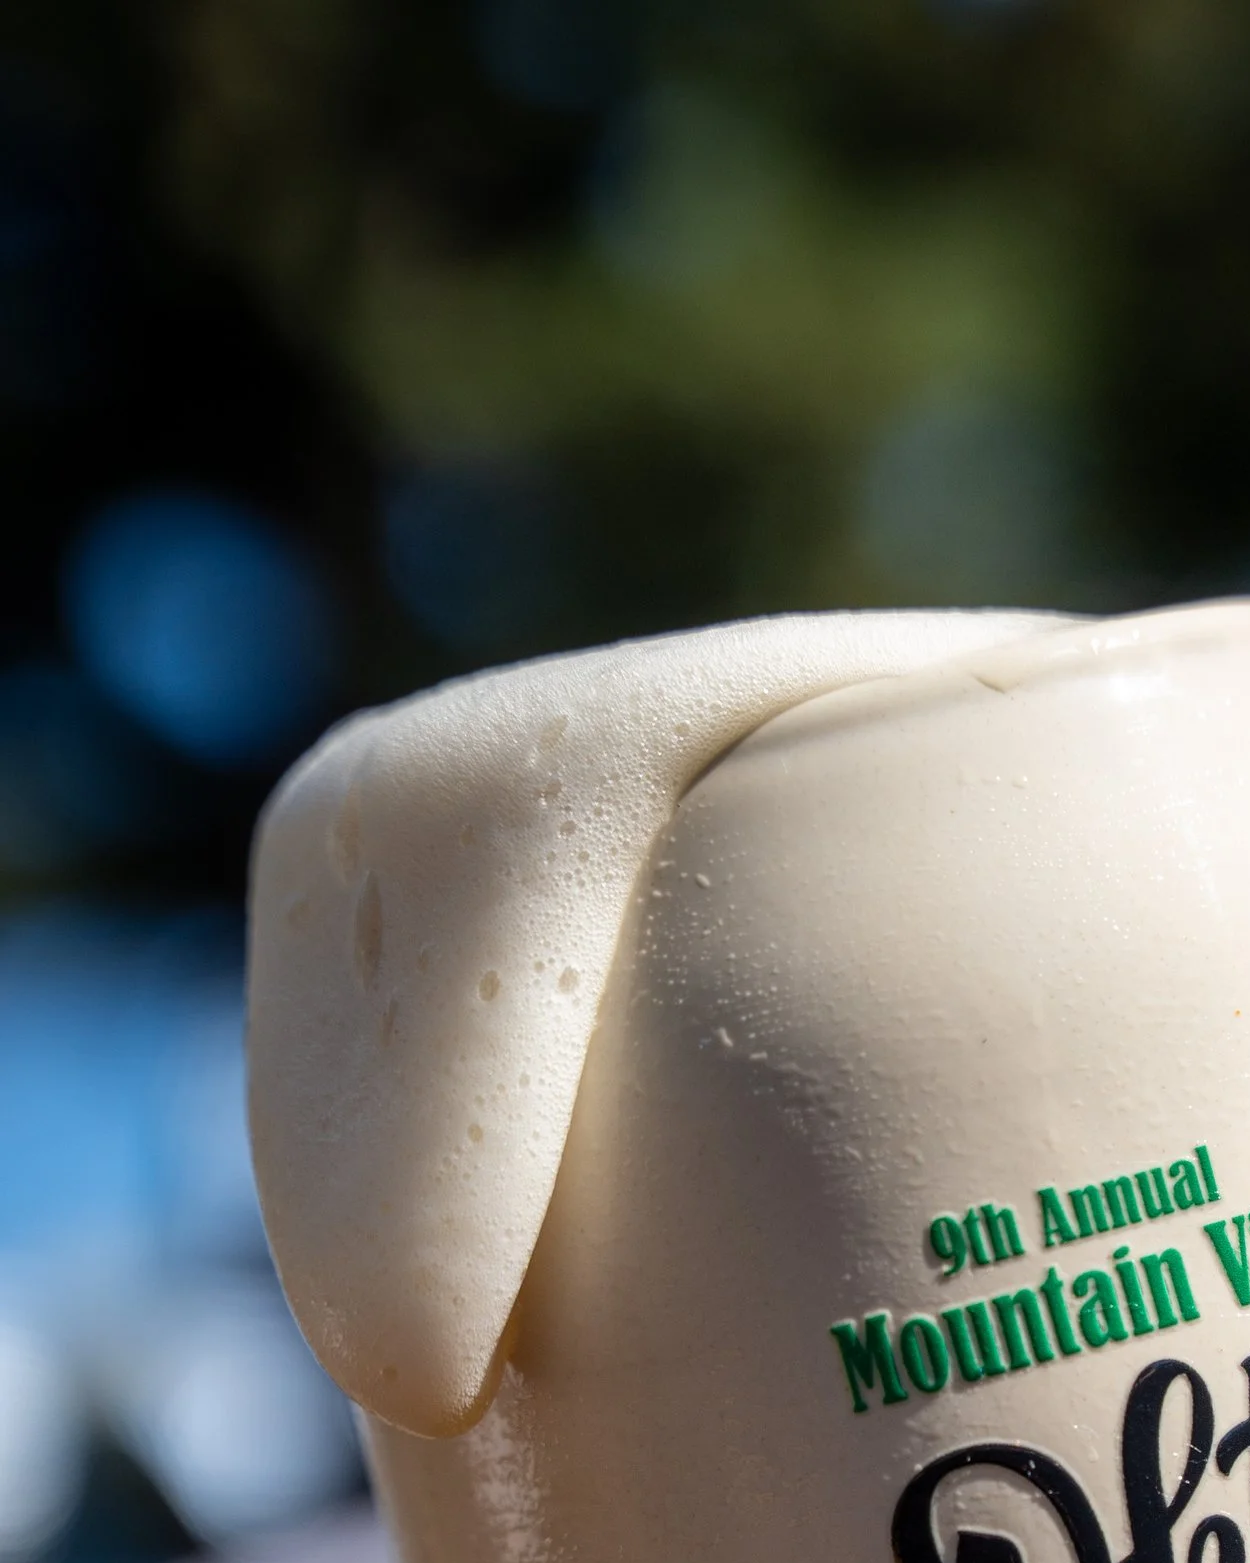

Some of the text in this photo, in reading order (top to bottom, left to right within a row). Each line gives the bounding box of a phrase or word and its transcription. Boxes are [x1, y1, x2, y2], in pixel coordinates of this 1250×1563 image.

[929, 1146, 1221, 1277] 9th Annual
[831, 1246, 1200, 1413] Mountain
